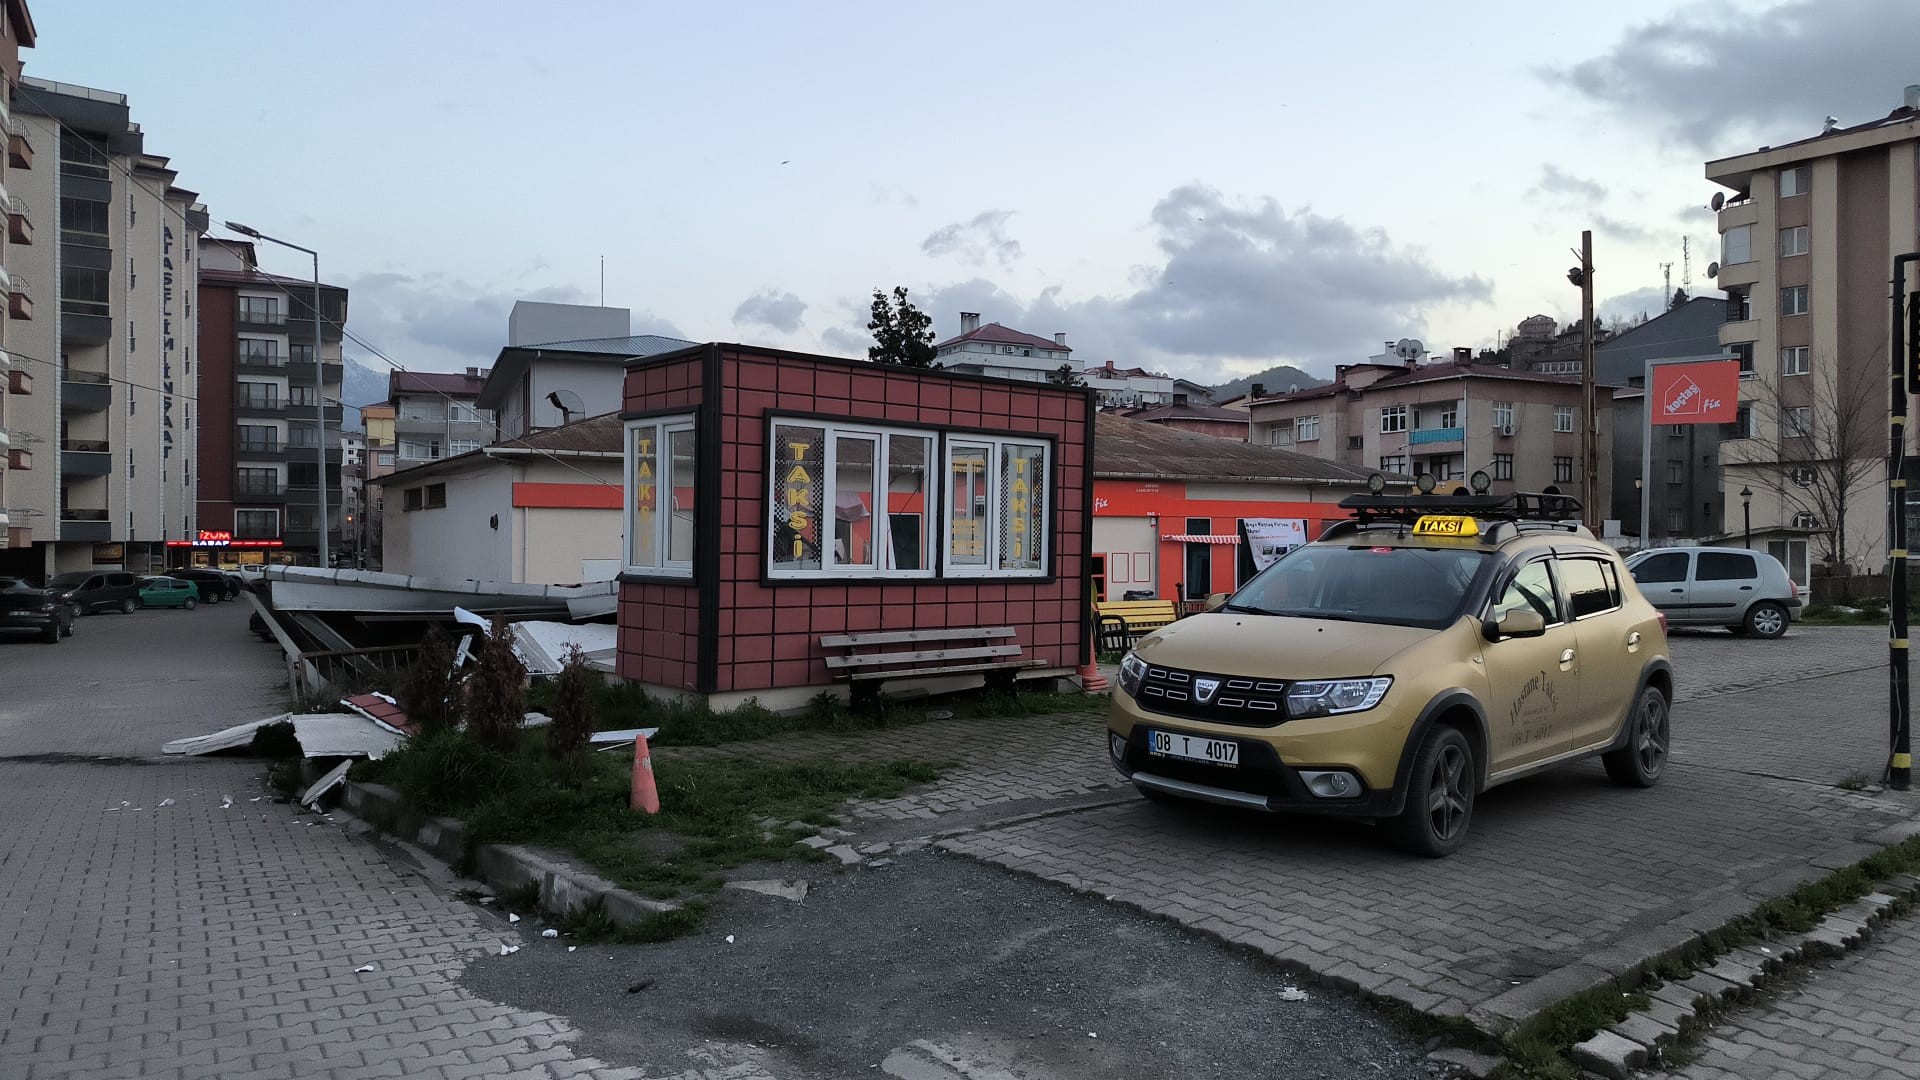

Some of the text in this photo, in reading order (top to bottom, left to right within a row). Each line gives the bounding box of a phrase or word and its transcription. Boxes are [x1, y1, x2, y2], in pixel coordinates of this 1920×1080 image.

[1665, 383, 1720, 413] koçtaş fix
[1156, 733, 1171, 752] 08
[1182, 737, 1190, 755] T
[1206, 741, 1237, 762] 4017
